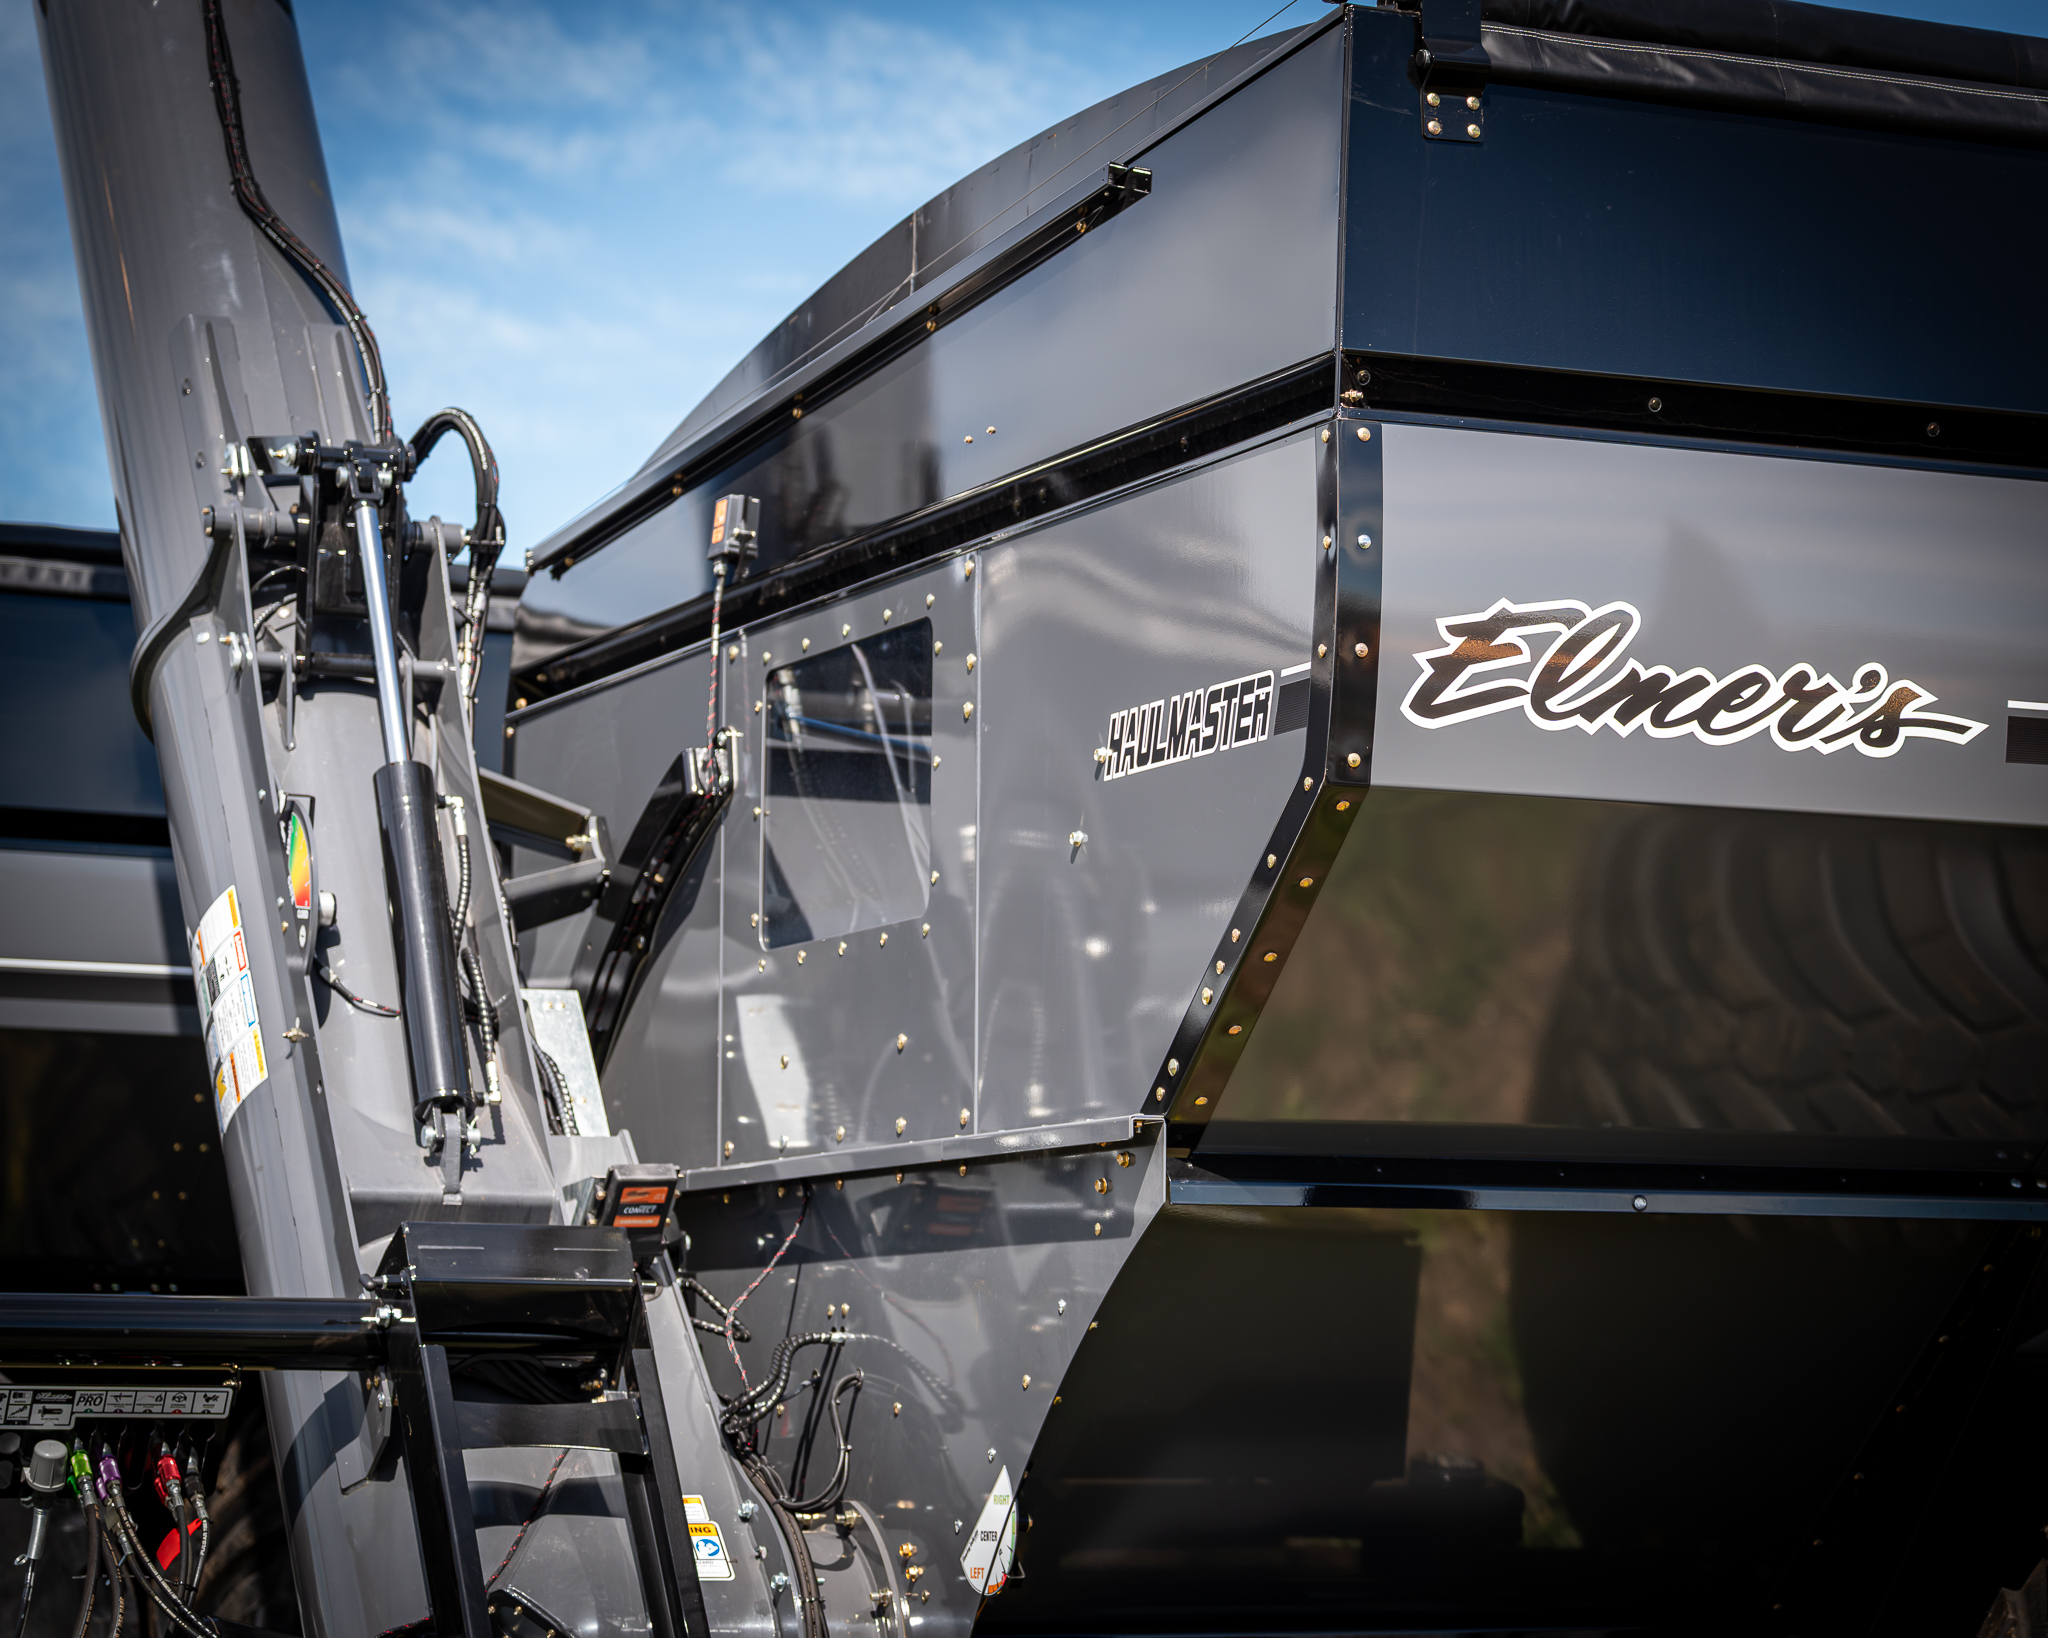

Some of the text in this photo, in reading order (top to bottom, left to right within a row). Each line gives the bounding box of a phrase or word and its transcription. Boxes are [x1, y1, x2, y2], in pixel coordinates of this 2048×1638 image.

[1400, 597, 1990, 758] Elmer's
[1104, 670, 1275, 781] HAULMASTER
[76, 1396, 103, 1406] PRO
[993, 1494, 1010, 1505] RIGHT
[980, 1531, 997, 1542] CENTER
[970, 1567, 984, 1579] LEFT
